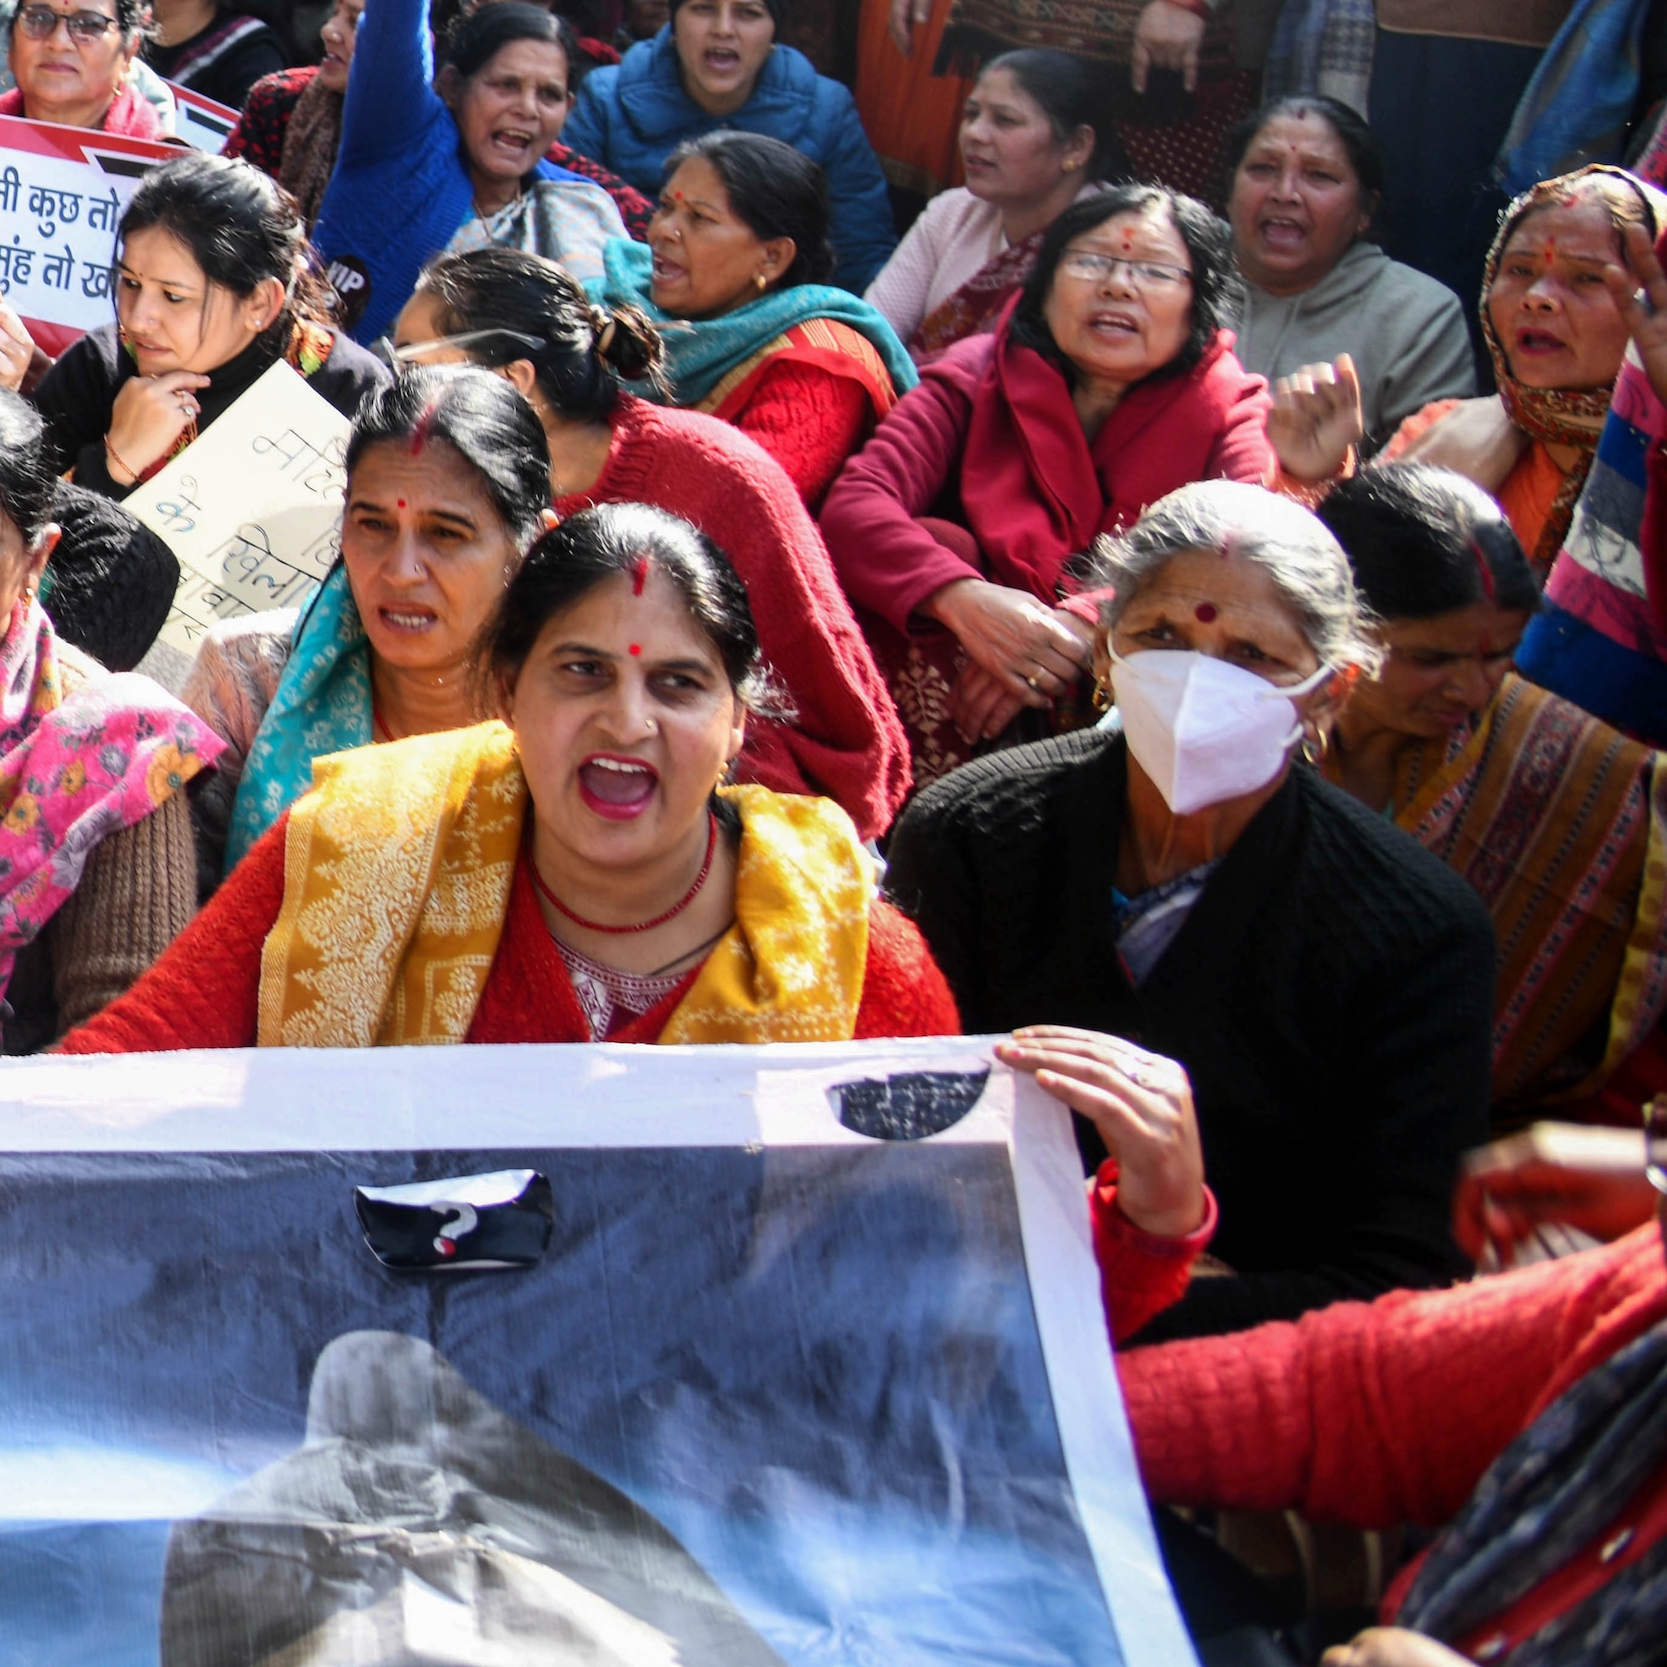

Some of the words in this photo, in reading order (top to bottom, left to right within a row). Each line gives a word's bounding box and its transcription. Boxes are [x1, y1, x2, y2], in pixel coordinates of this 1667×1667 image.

[28, 184, 83, 238] कुछ
[88, 187, 120, 234] तो
[42, 244, 75, 290] तो
